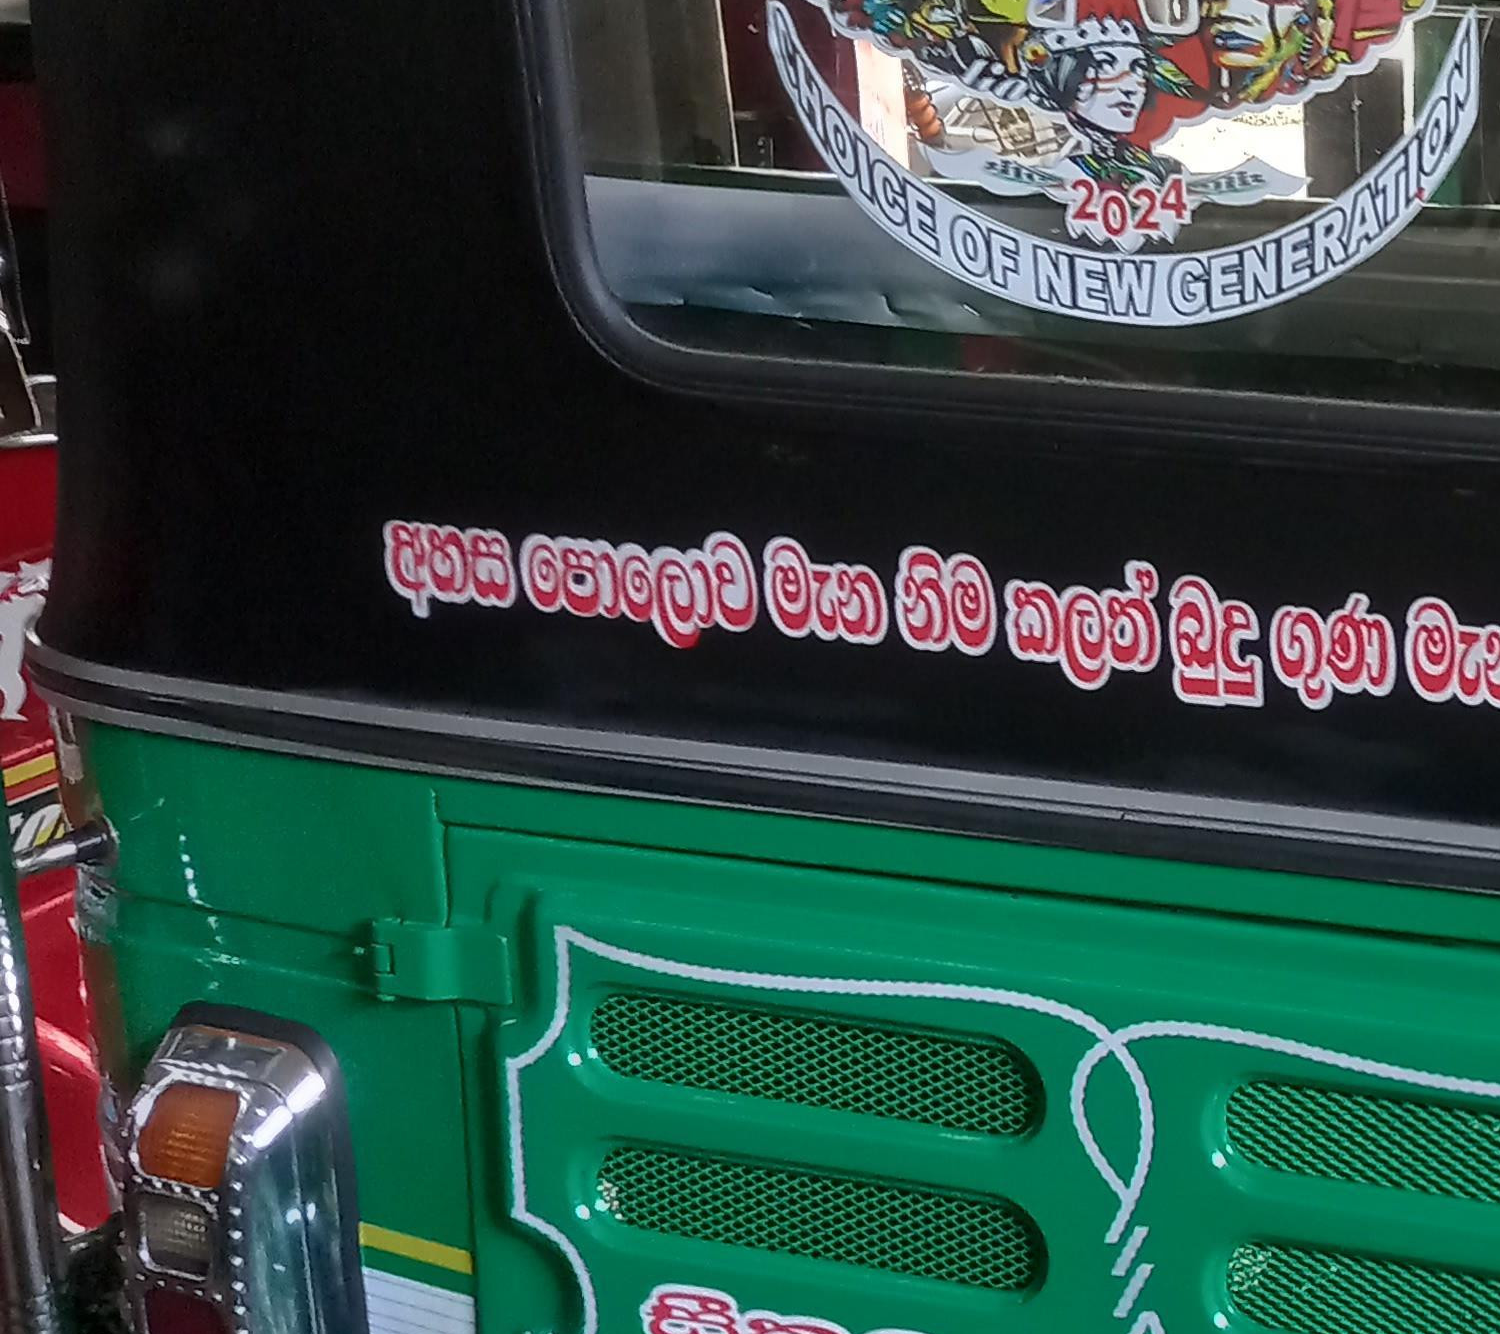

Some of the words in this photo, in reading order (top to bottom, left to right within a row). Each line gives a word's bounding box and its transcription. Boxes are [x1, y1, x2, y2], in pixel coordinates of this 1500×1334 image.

[774, 5, 941, 259] CHOICE
[951, 216, 1024, 291] OF
[1033, 246, 1157, 320] NEW
[1166, 22, 1474, 317] GENERATION
[1073, 179, 1187, 237] 2024
[384, 521, 516, 617] අහස
[521, 533, 757, 648] පොලොව
[764, 538, 888, 644] මැන
[895, 547, 996, 655] නිම
[1169, 576, 1263, 706] බුදු
[1270, 594, 1395, 709] ගුණ
